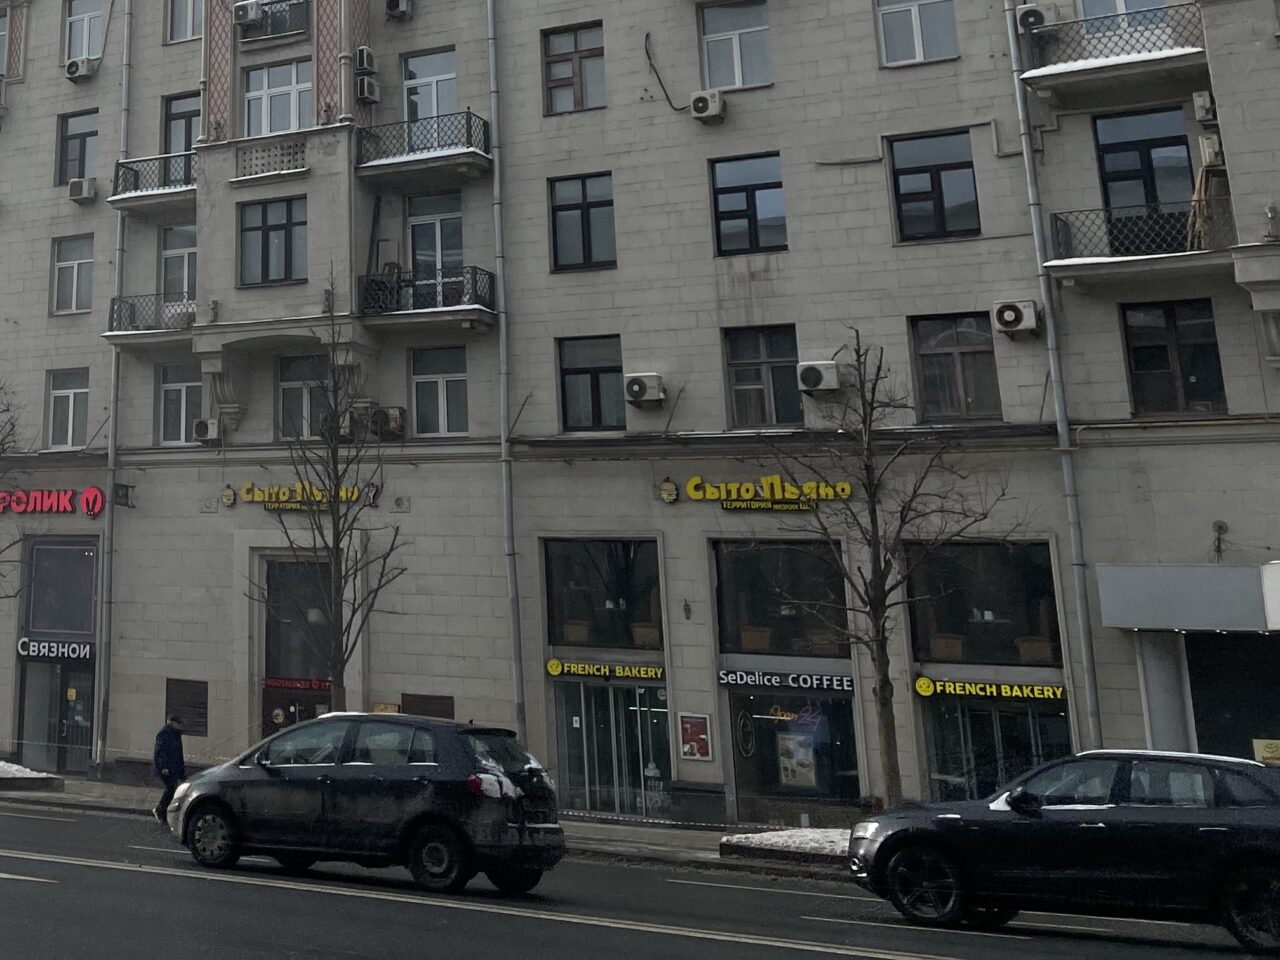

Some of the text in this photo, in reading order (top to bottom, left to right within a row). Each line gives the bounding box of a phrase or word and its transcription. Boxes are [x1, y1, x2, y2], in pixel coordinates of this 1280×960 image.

[563, 663, 663, 680] FRENCH BAKERY
[719, 670, 853, 691] SeDelice COFFEE
[935, 681, 1063, 699] FRENCH BAKERY
